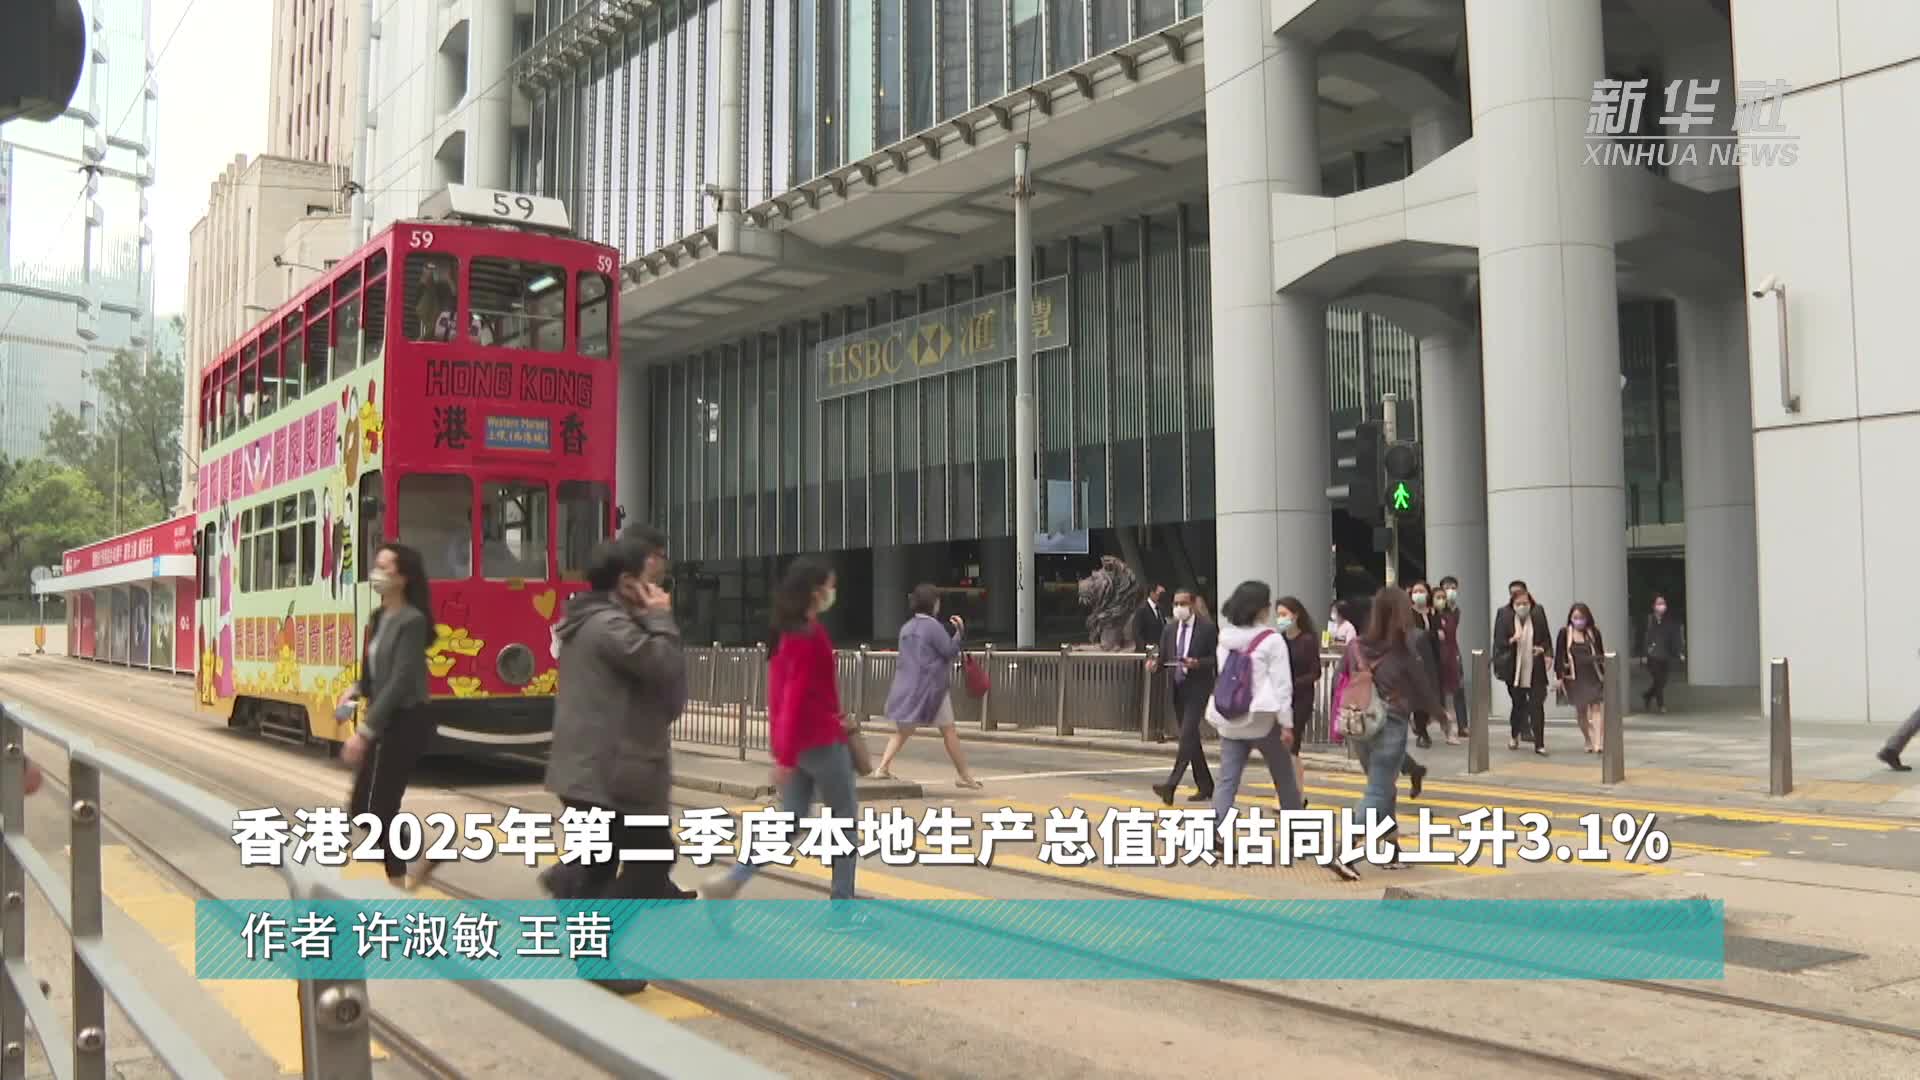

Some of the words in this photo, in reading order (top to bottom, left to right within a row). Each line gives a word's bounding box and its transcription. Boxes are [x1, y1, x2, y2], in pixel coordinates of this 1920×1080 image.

[492, 192, 535, 219] 59
[409, 230, 434, 249] 59
[596, 254, 613, 273] 59
[826, 332, 904, 386] HSBC
[425, 359, 513, 398] HONG
[519, 363, 593, 409] KONG
[432, 403, 472, 450] 港
[559, 412, 588, 456] 香
